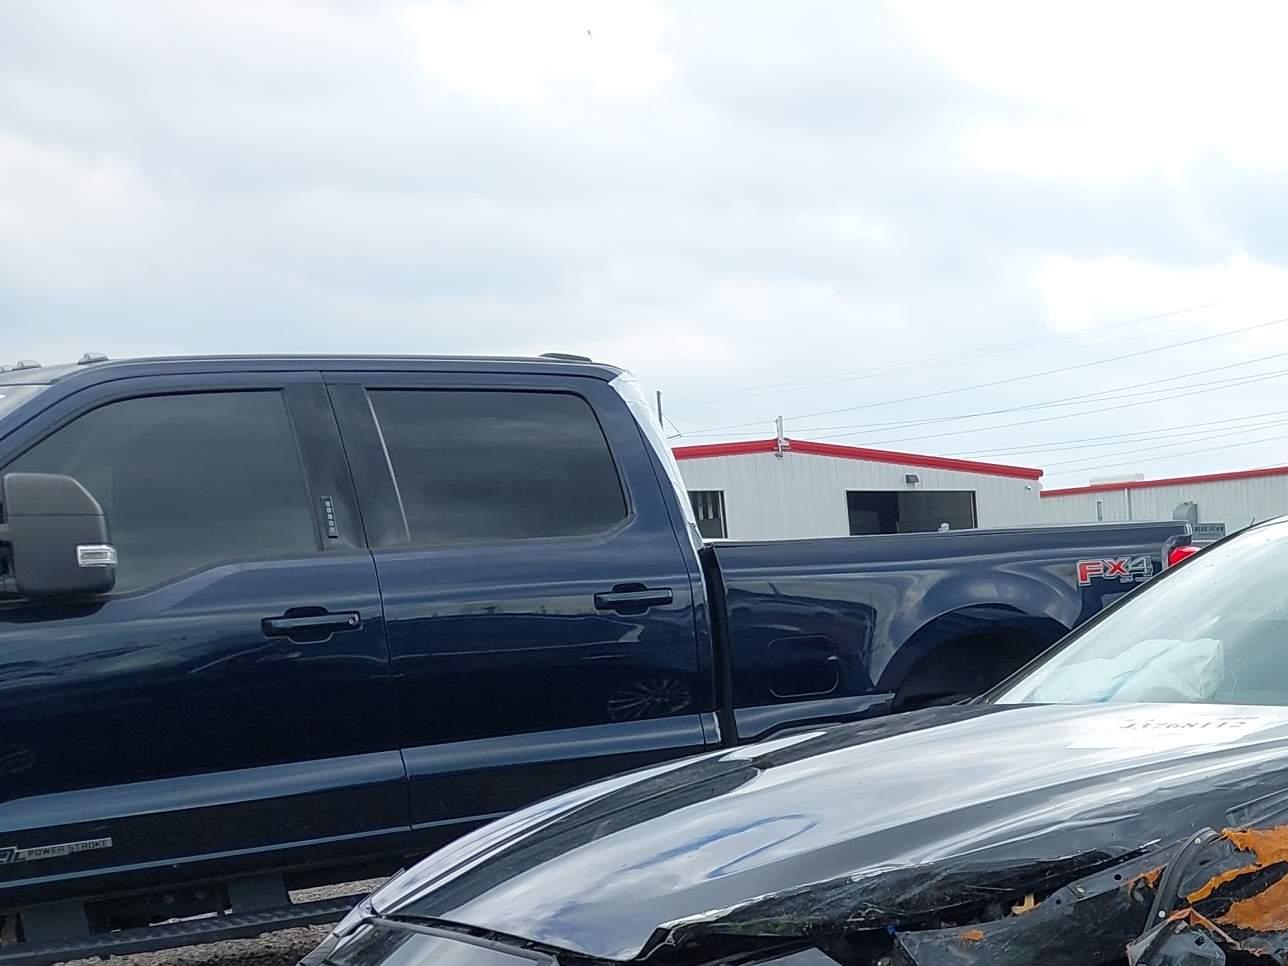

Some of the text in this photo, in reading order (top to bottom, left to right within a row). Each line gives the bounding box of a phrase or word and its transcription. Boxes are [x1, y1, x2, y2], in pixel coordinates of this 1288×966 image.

[1076, 555, 1154, 587] FX4
[27, 846, 65, 858] POWER
[67, 838, 109, 852] STROKE
